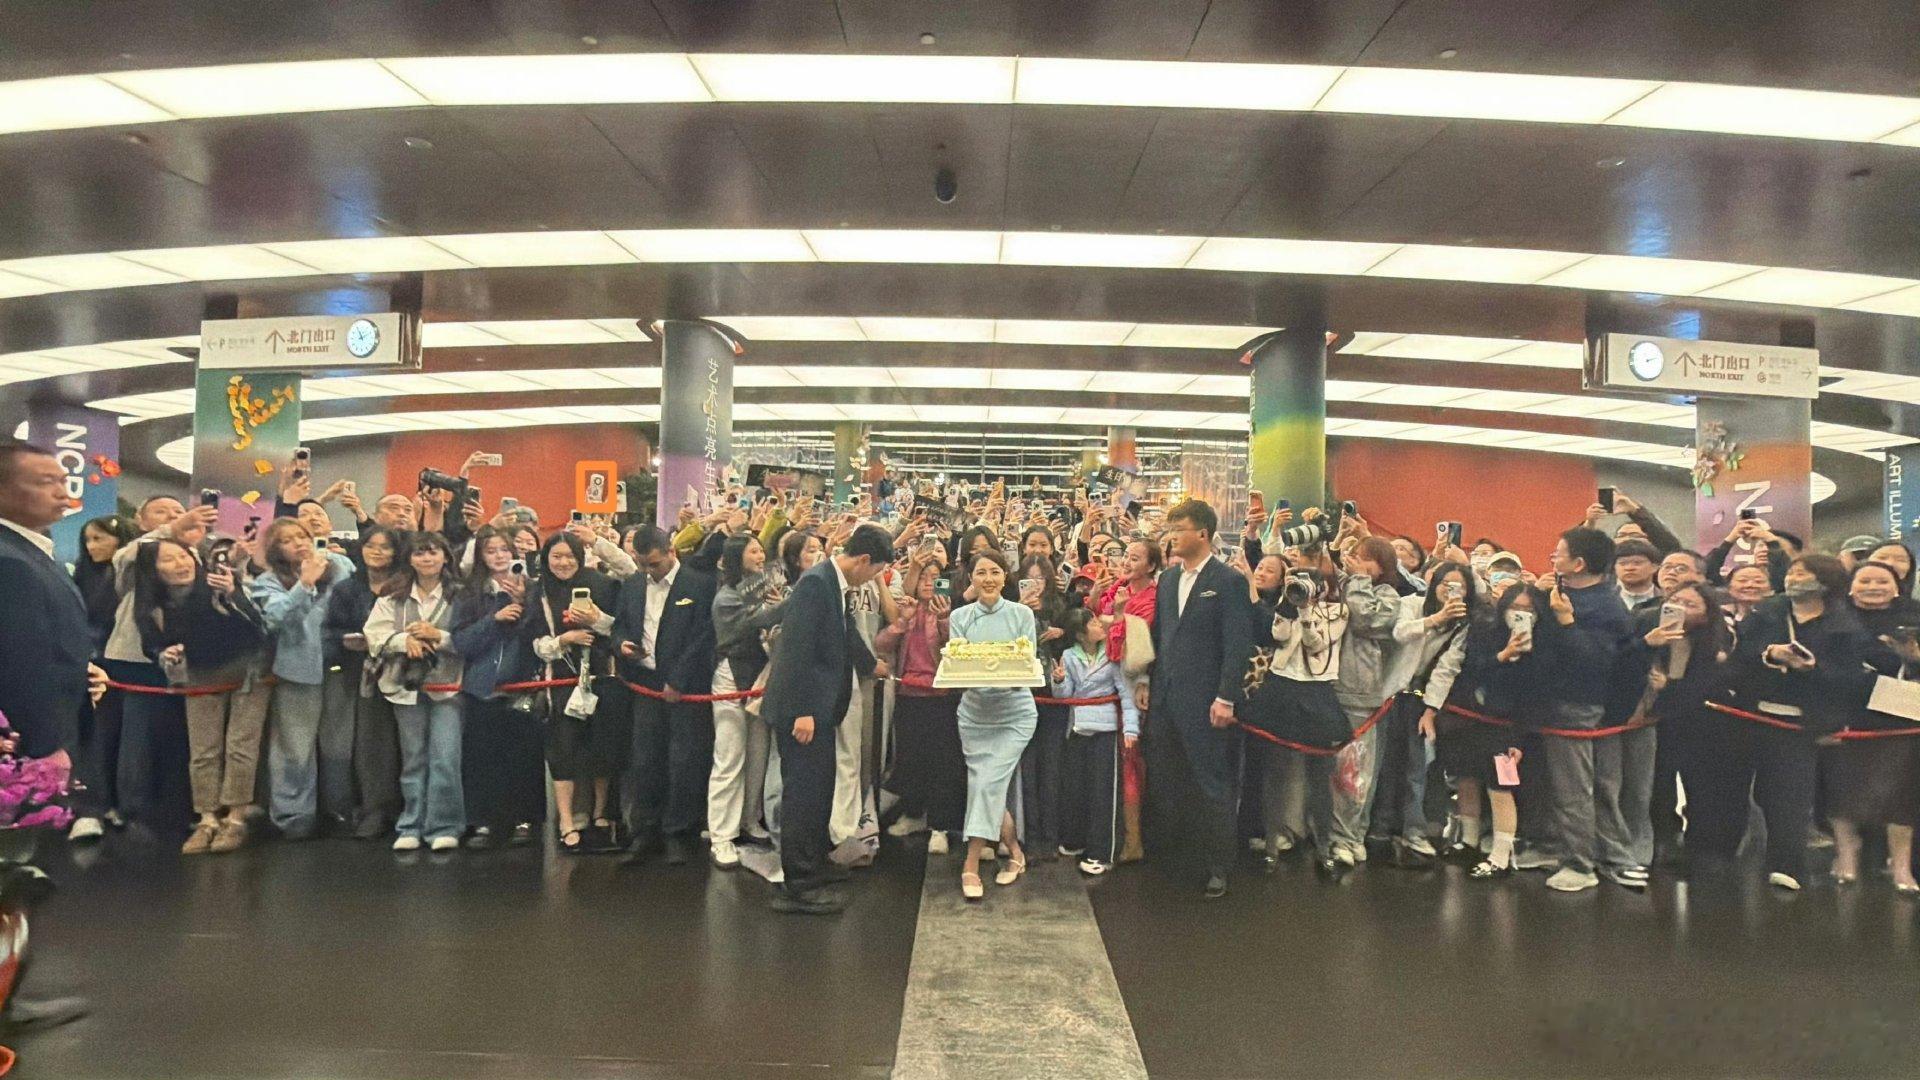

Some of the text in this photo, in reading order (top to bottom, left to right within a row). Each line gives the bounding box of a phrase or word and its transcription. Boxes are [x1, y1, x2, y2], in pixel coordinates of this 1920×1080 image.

[287, 329, 336, 344] 北门出口
[287, 345, 330, 354] NORTH EXIT
[1699, 354, 1750, 370] 北门出口
[1699, 371, 1744, 381] NORTH EXIT
[1889, 453, 1902, 487] ART
